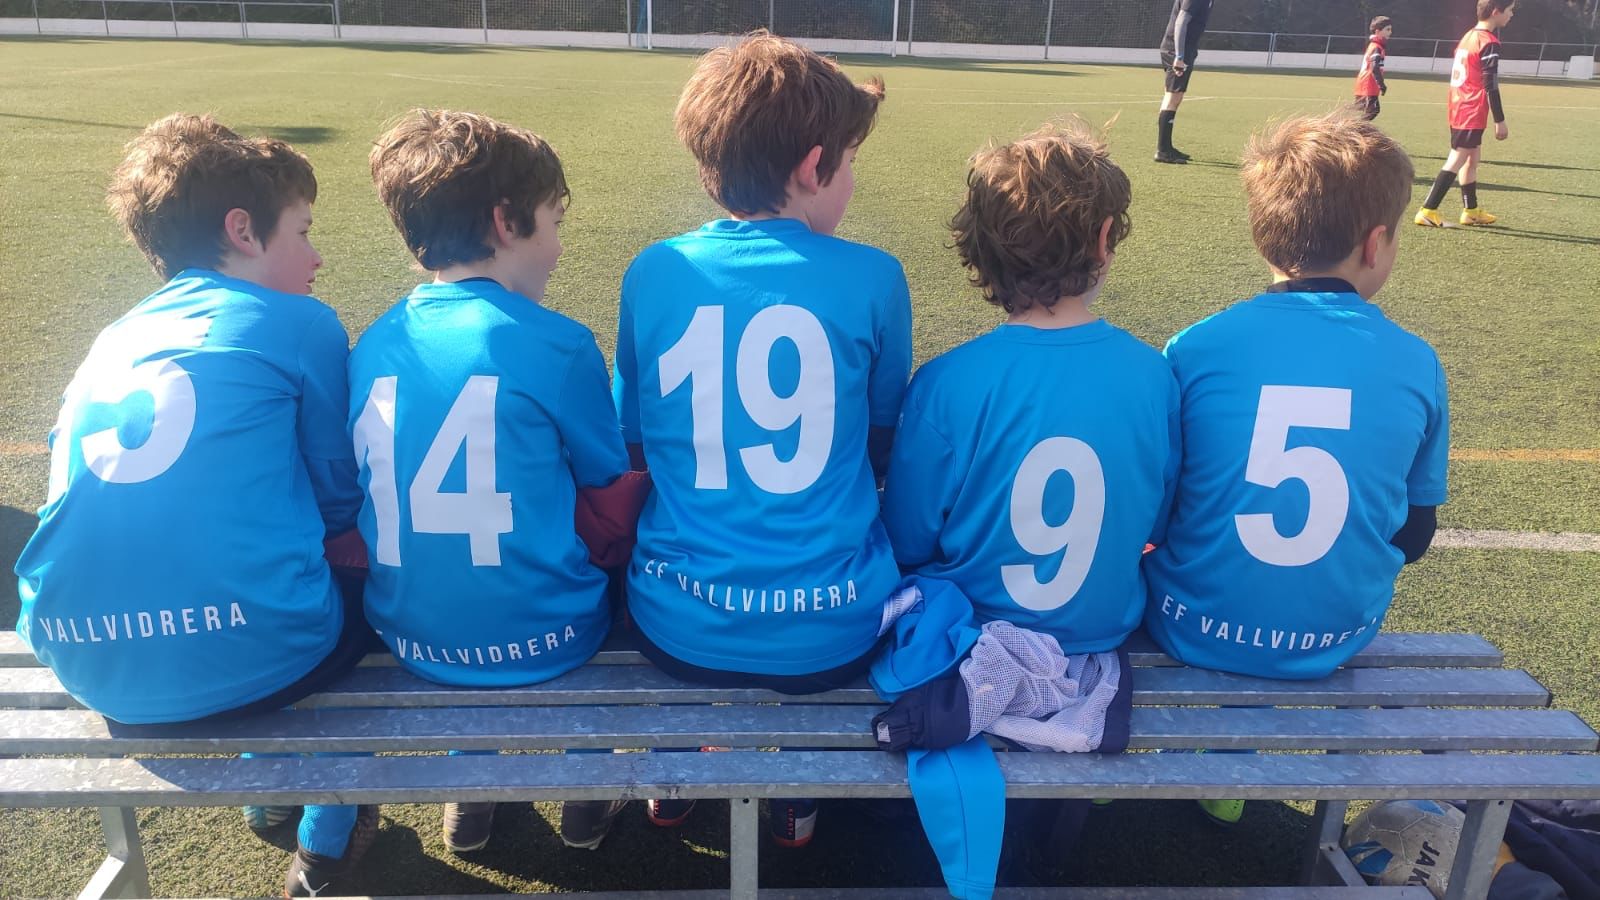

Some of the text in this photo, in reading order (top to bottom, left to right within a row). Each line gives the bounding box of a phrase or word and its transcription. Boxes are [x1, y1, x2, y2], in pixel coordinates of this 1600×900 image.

[658, 304, 836, 495] 19
[353, 375, 513, 567] 14
[1234, 384, 1353, 567] 5
[1001, 435, 1106, 611] 9
[677, 572, 857, 613] VALLVIDRERA
[39, 602, 248, 643] VALLVIDRERA
[396, 624, 576, 665] VALLVIDRERA
[1160, 593, 1378, 650] EF VALLVIDRE
[1407, 840, 1441, 887] JAK
